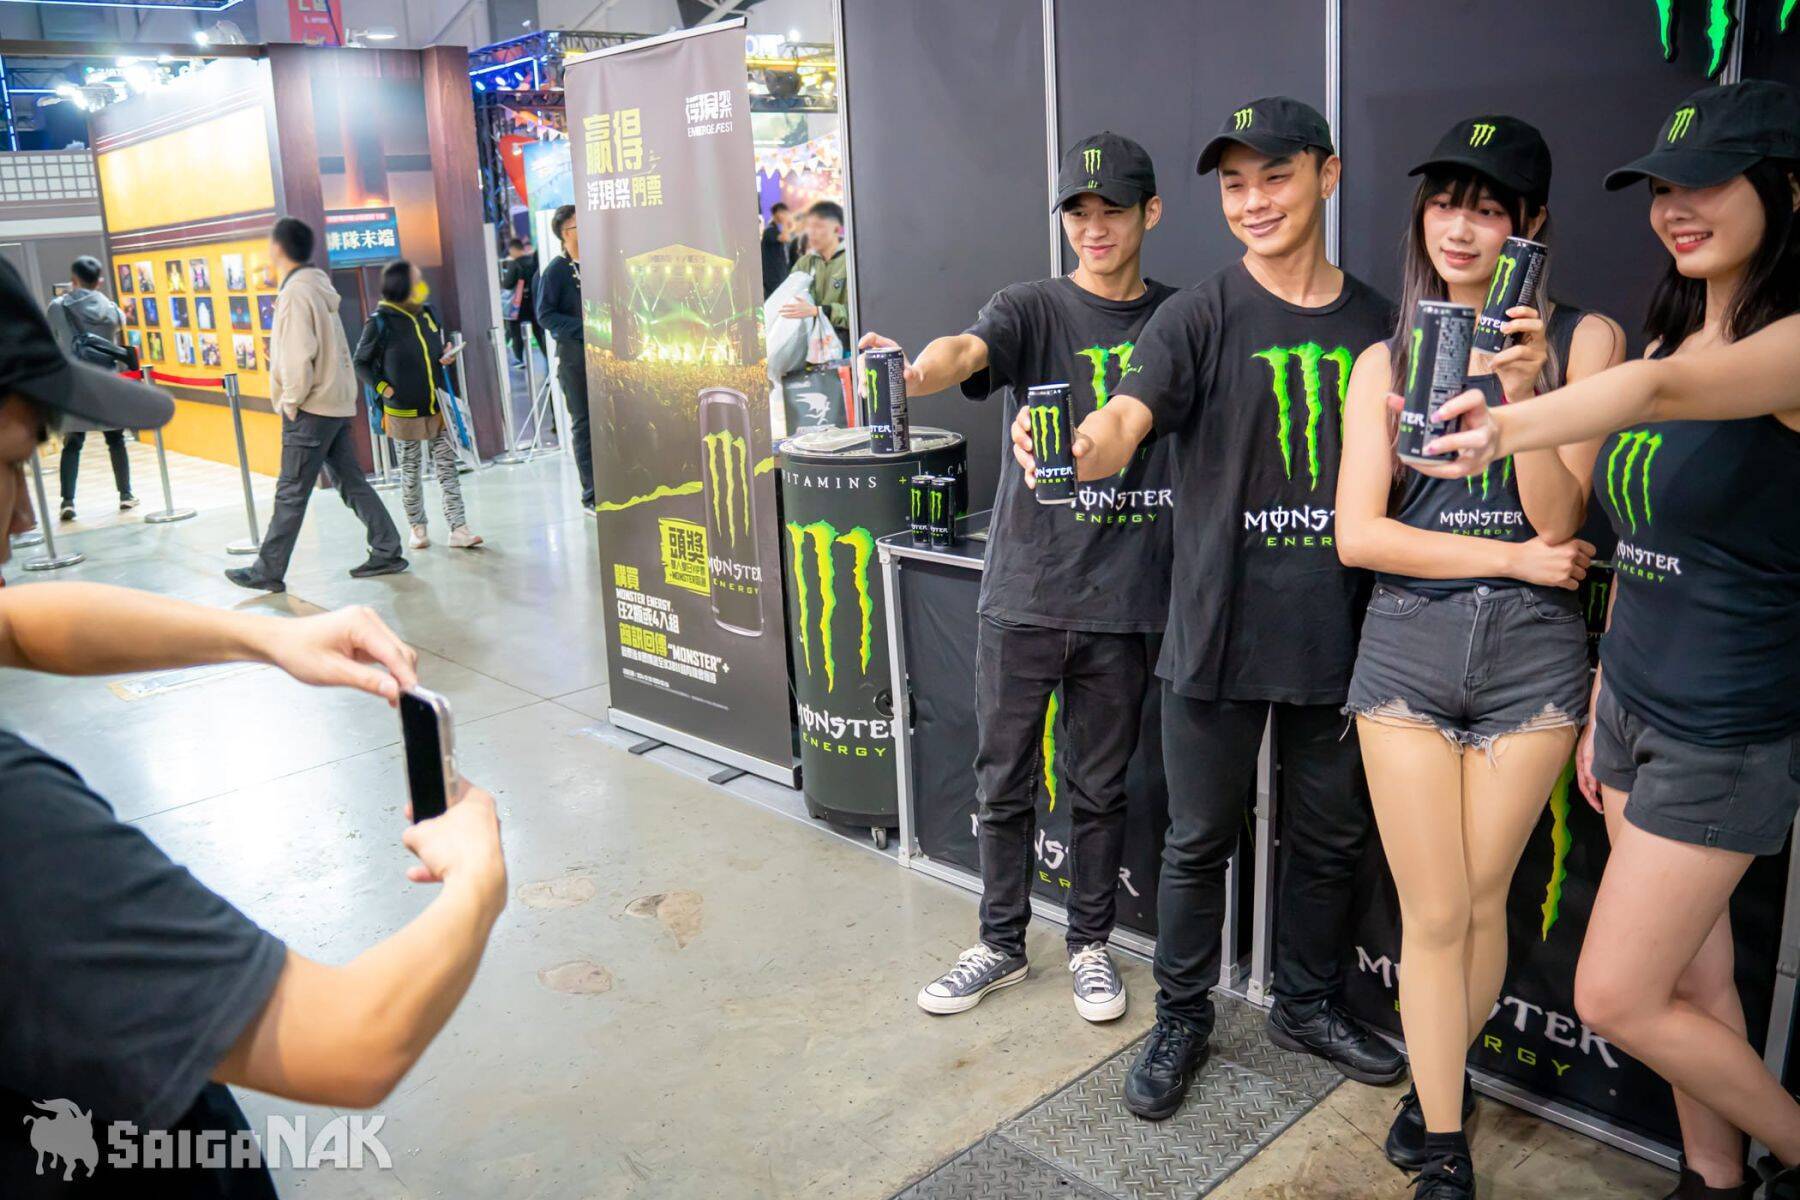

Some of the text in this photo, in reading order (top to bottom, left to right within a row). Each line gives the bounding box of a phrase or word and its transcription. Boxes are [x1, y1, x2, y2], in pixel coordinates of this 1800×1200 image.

[1036, 466, 1074, 478] NSTER
[1070, 486, 1173, 511] ONSTER
[1075, 512, 1158, 524] ENERGY
[1244, 504, 1336, 533] MONS
[1440, 508, 1524, 528] MONSTER
[1267, 536, 1333, 547] ENER
[1452, 528, 1513, 536] ENERGY
[615, 587, 646, 606] MONSTER
[802, 731, 887, 757] ENERGY
